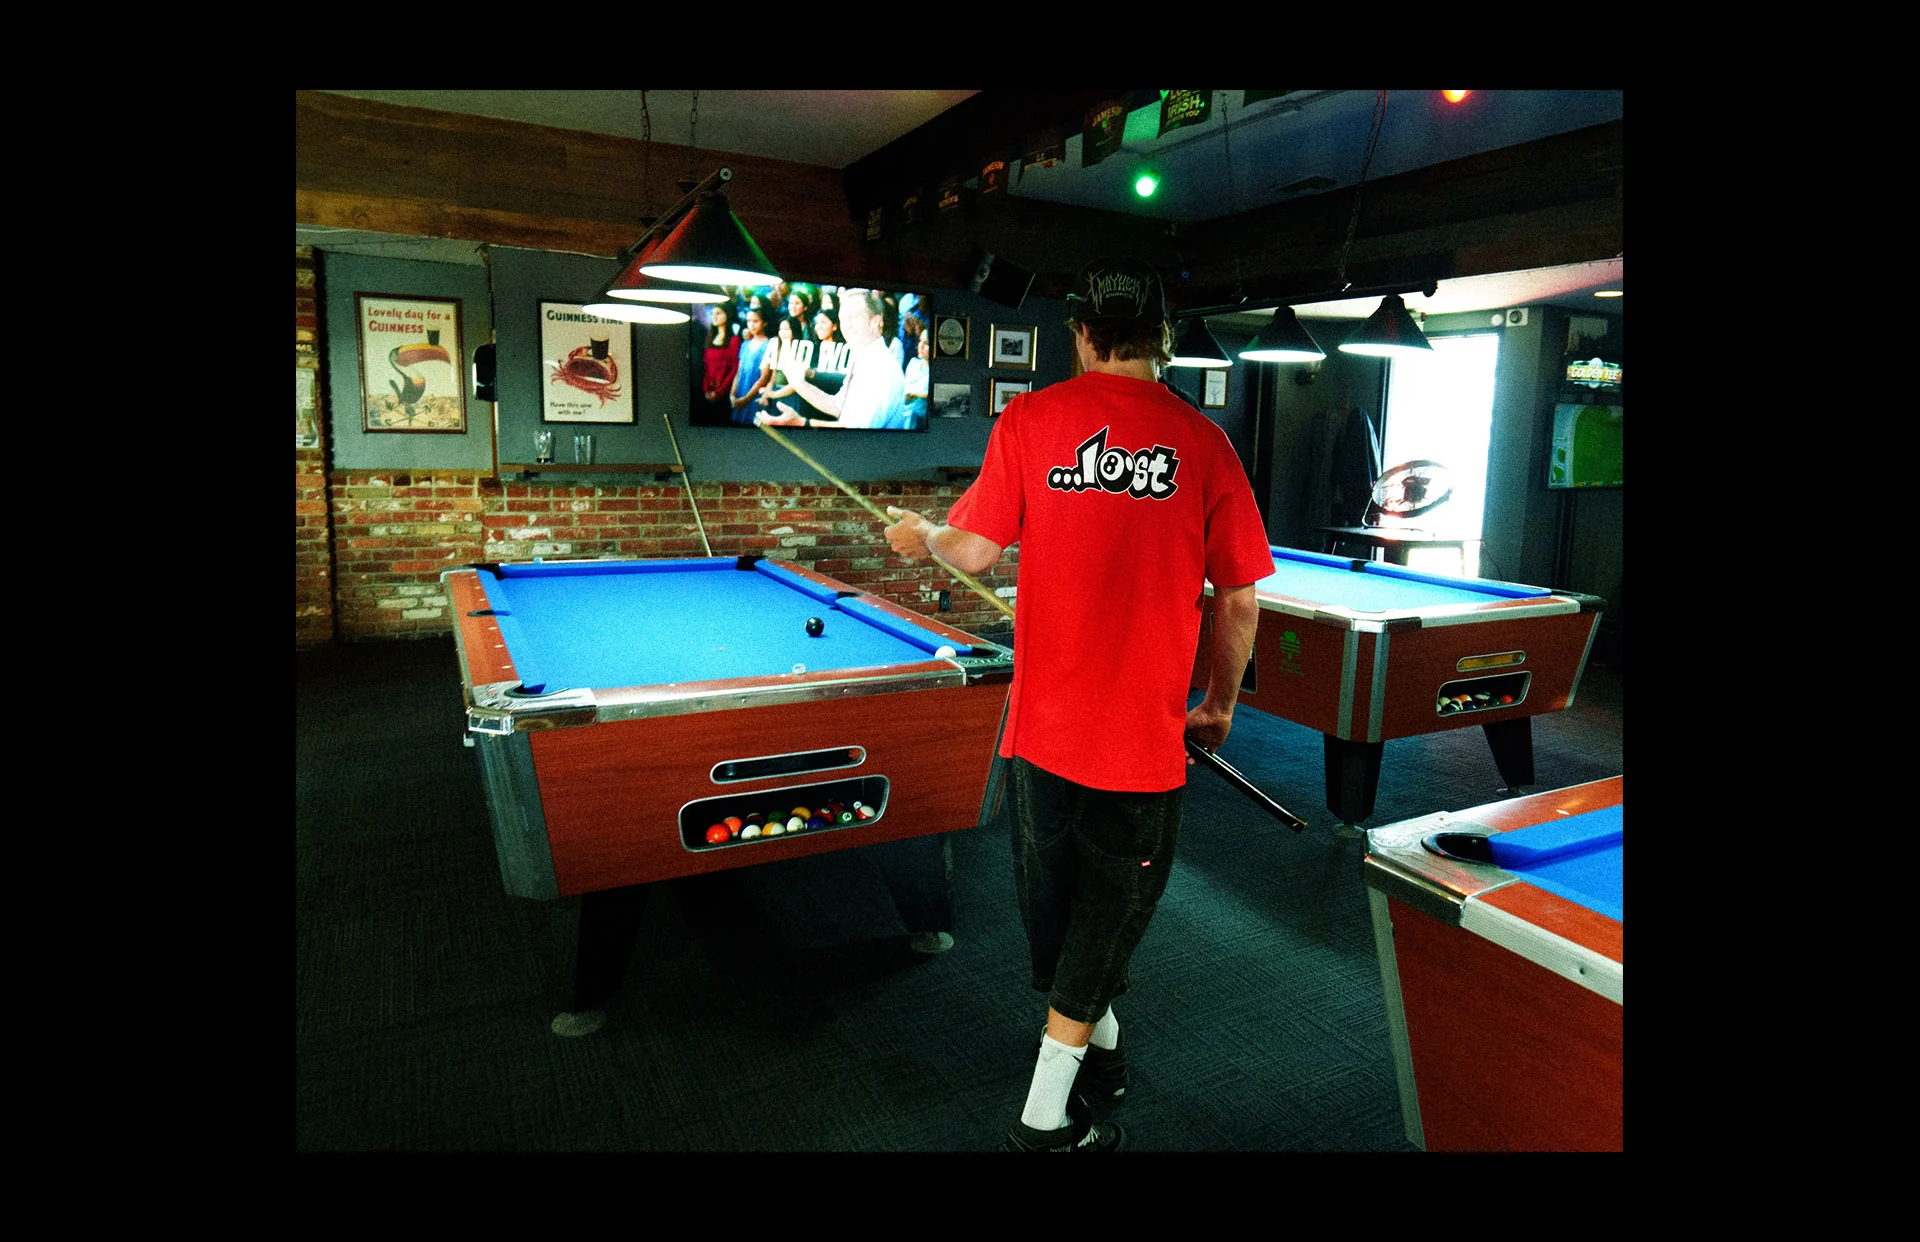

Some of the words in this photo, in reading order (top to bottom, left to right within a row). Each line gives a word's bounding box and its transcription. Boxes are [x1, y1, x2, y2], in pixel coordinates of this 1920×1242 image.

[1167, 94, 1200, 119] IRISH
[367, 307, 401, 320] Lovely
[404, 309, 424, 320] day
[426, 310, 441, 320] for
[546, 309, 598, 324] GUINNESS
[368, 320, 424, 334] GUINNESS
[1571, 366, 1603, 379] GOLDEN
[1606, 368, 1618, 380] TEE
